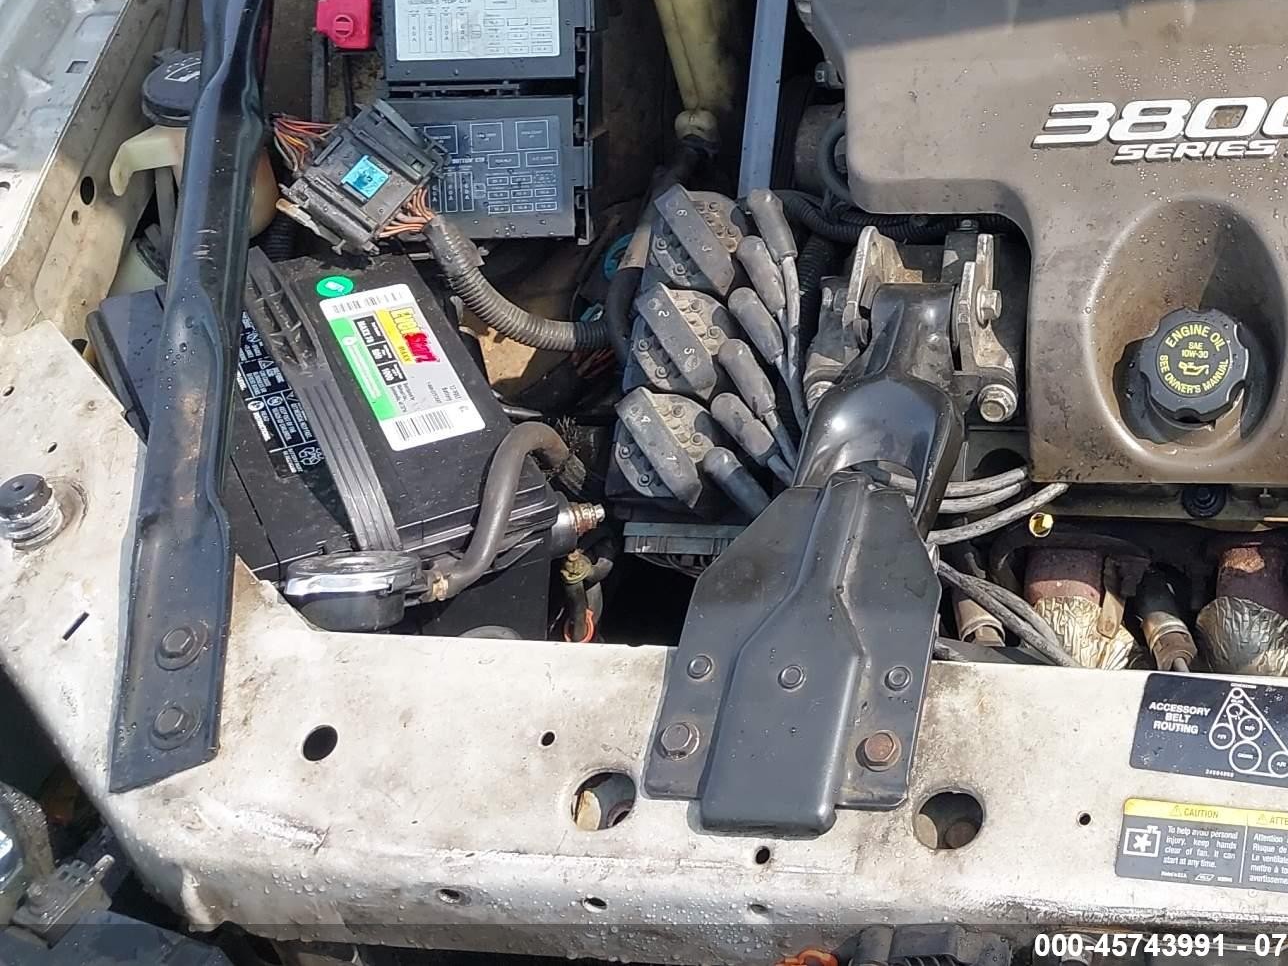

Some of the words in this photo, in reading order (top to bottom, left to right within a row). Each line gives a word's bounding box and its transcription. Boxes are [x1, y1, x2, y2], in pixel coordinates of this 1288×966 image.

[1111, 140, 1279, 164] SERIES
[1165, 324, 1211, 348] ENGINE
[1209, 332, 1226, 352] OIL
[1188, 341, 1204, 350] SAE
[1181, 349, 1209, 359] 10W-30
[1159, 354, 1170, 373] SEE
[1201, 358, 1229, 391] MANUAL
[1164, 372, 1202, 394] OWNER'S
[1149, 702, 1211, 717] ACCESSORY
[1165, 713, 1191, 724] BELT
[1153, 720, 1199, 735] ROUTING
[1183, 808, 1219, 819] CAUTION
[1176, 827, 1191, 836] help
[1210, 831, 1239, 840] personal
[1253, 833, 1284, 843] Attention
[1164, 846, 1182, 854] clear
[1223, 852, 1236, 860] can
[1252, 842, 1276, 853] Risque
[1278, 845, 1288, 854] de
[1163, 855, 1179, 865] start
[1187, 859, 1201, 869] any
